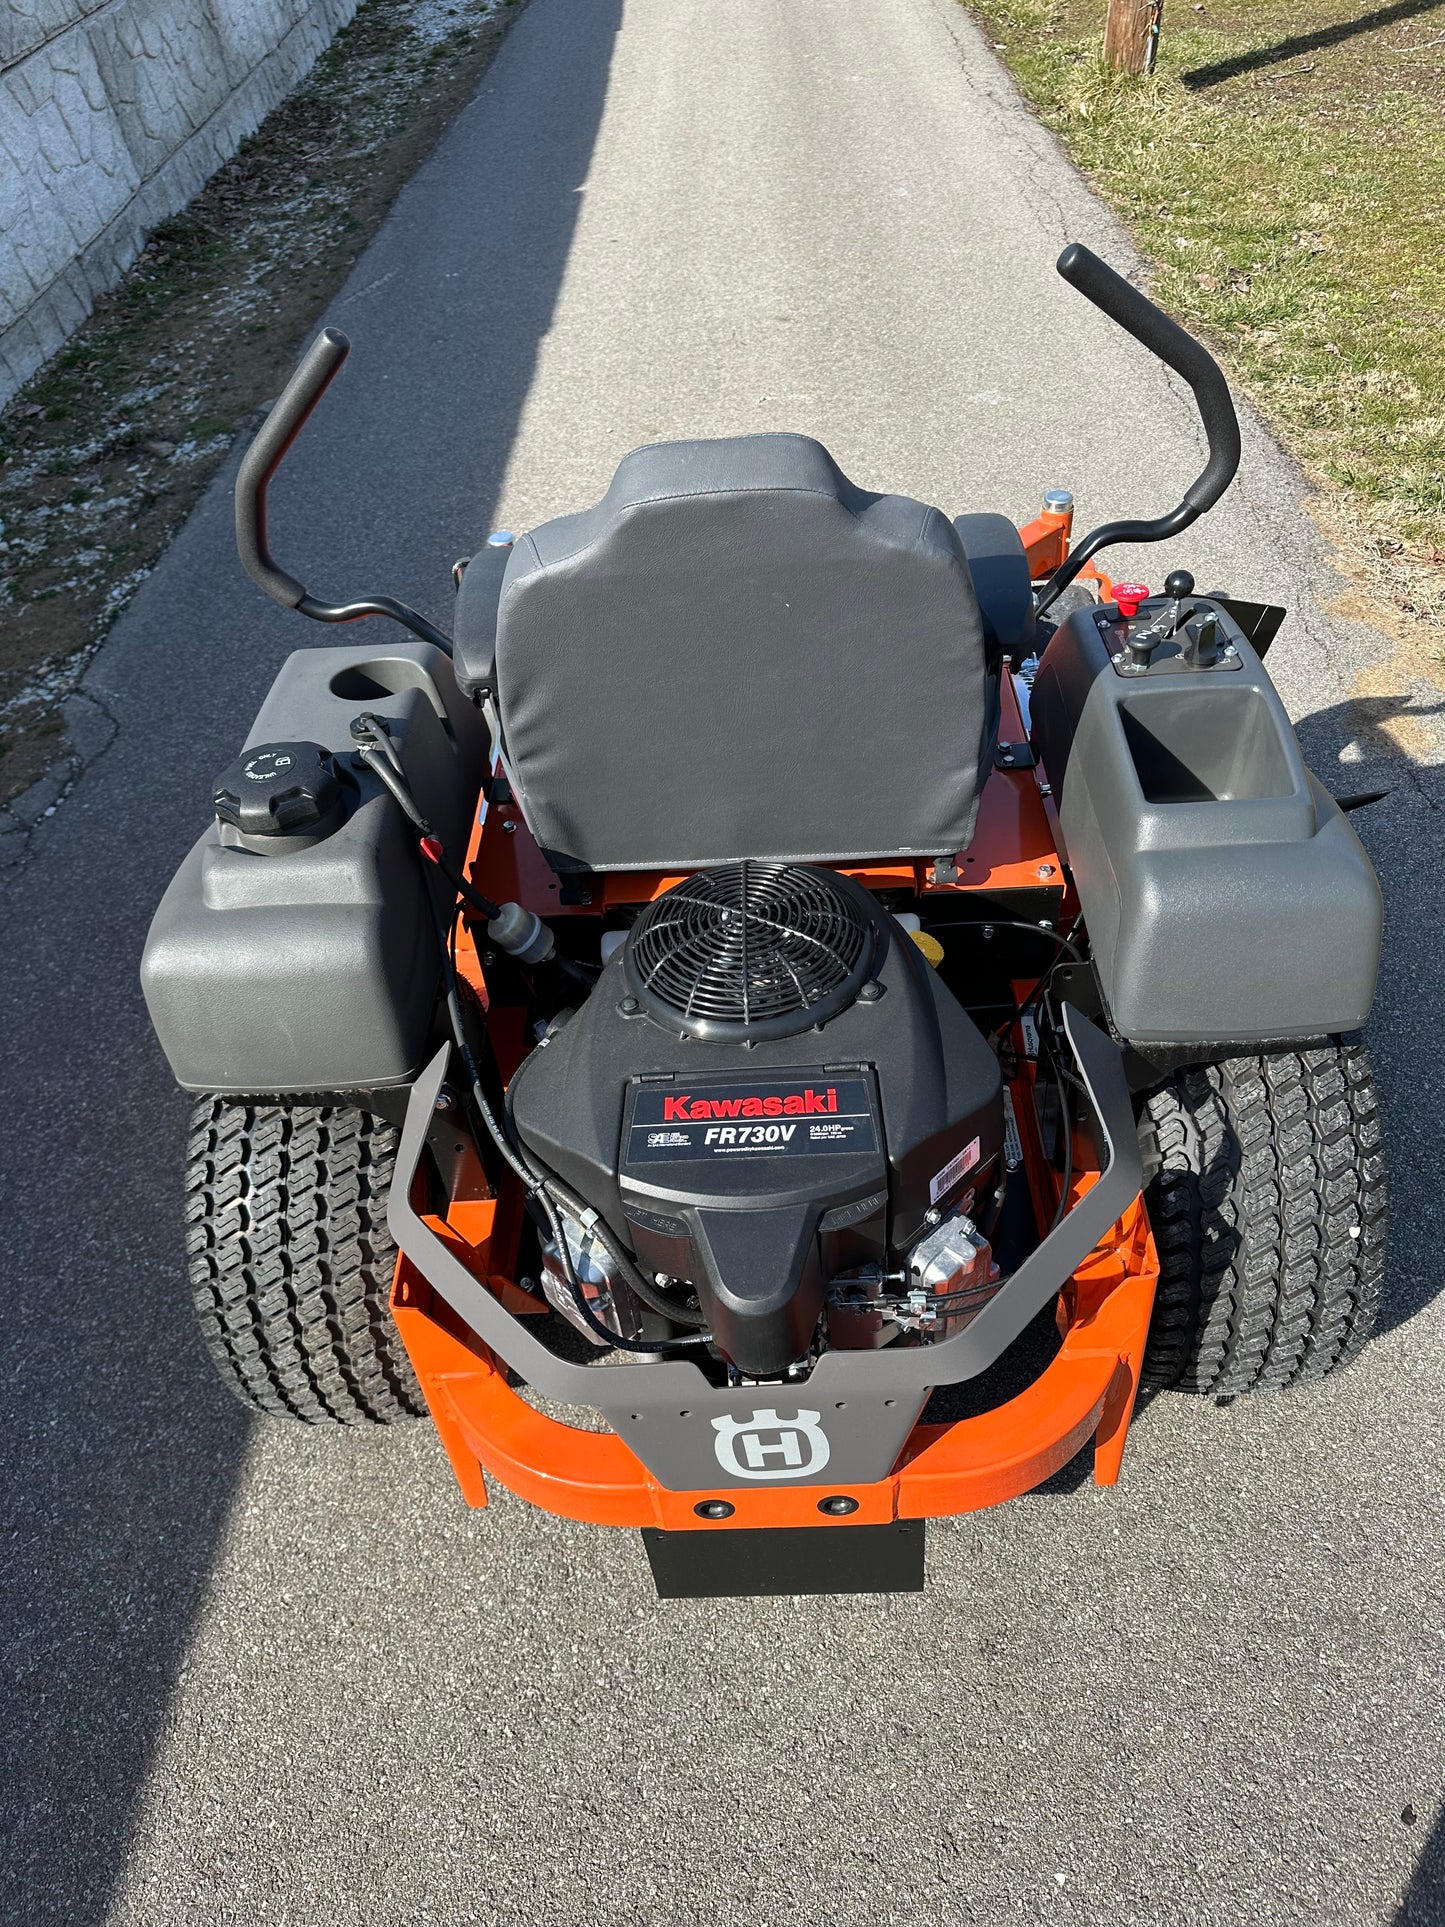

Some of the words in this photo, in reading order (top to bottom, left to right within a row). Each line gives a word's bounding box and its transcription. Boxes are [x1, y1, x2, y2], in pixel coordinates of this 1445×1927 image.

[245, 761, 257, 771] FUEL
[1025, 1025, 1034, 1053] Husqvarna
[664, 1089, 837, 1120] Kawasaki
[704, 1124, 796, 1145] FR730V
[651, 1216, 677, 1231] HERE
